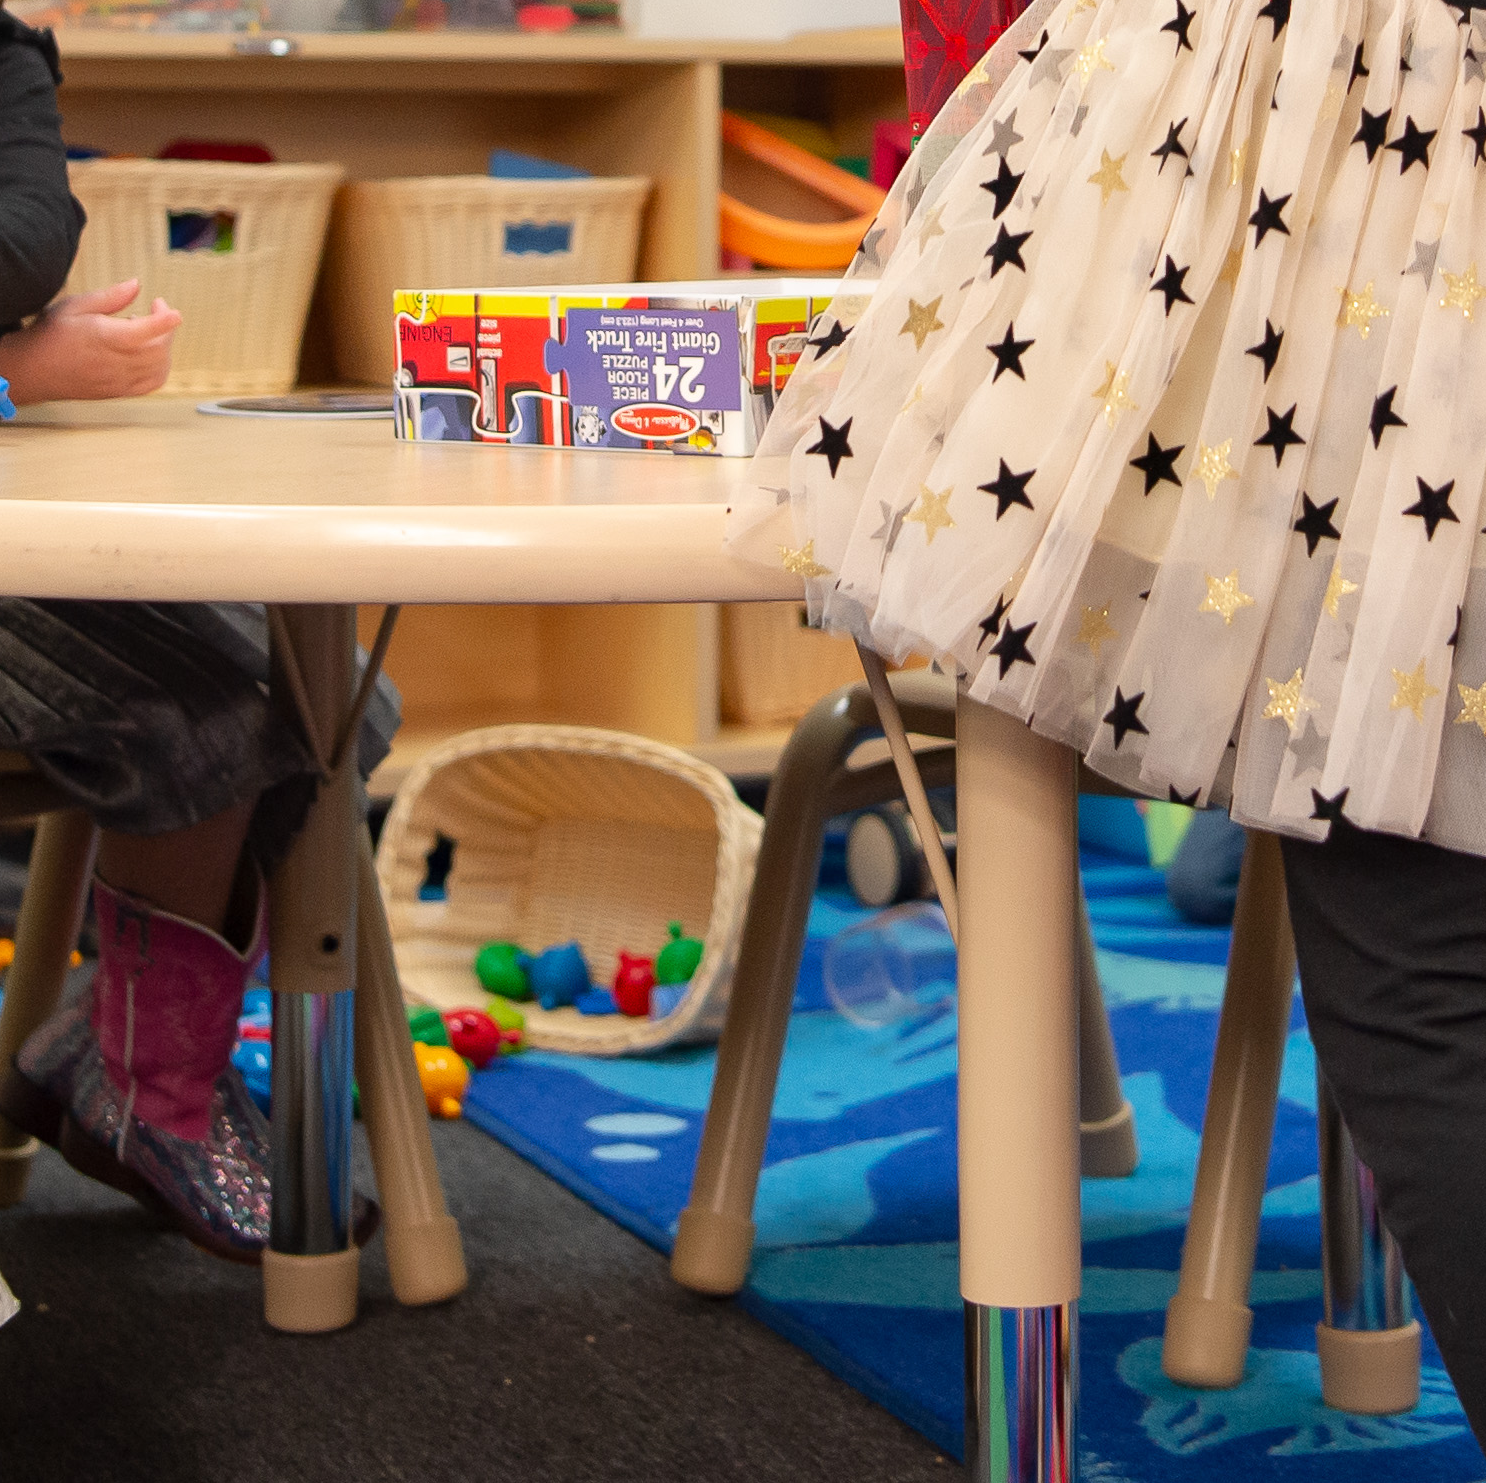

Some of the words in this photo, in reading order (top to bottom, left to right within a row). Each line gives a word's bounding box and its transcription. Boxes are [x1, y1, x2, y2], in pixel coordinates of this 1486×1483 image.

[480, 319, 498, 330] size
[641, 315, 659, 327] Long
[662, 317, 677, 327] Feet
[678, 318, 683, 327] 4
[685, 318, 704, 328] Over
[478, 332, 501, 344] piece
[586, 329, 633, 353] Truck
[636, 331, 667, 353] Fire
[672, 331, 721, 354] Giant
[602, 355, 648, 369] PUZZLE
[607, 371, 649, 384] FLOOR
[652, 356, 705, 402] 24
[613, 386, 649, 399] PIECE
[619, 410, 642, 429] Doug
[652, 415, 690, 431] Melissa
